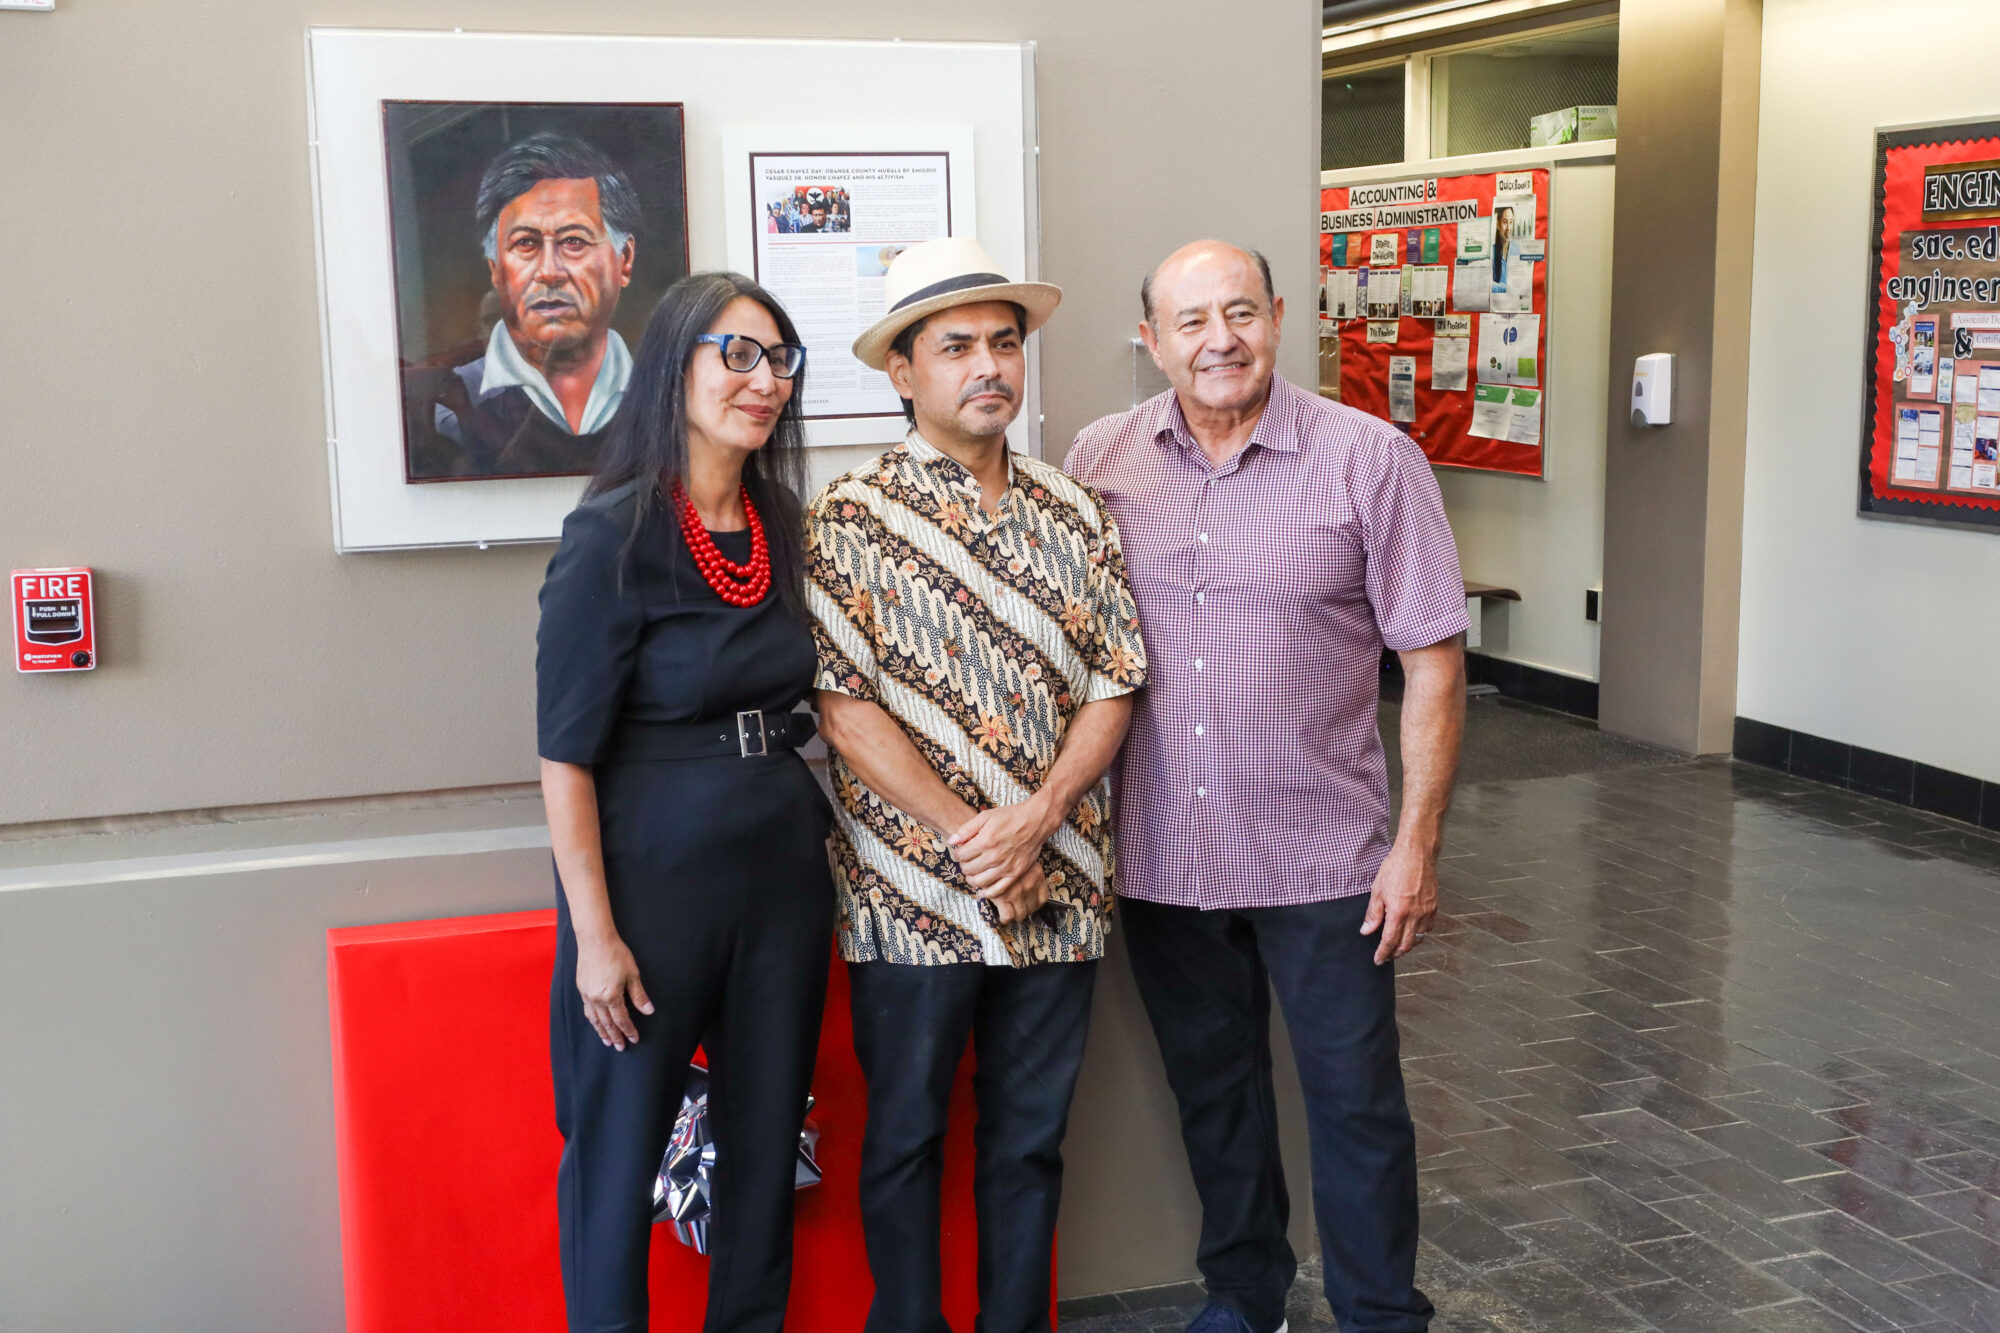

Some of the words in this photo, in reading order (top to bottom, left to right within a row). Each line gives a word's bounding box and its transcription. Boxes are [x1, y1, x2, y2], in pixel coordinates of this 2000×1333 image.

[1351, 184, 1424, 206] ACCOUNTING
[1427, 181, 1437, 199] &
[1321, 213, 1373, 231] BUSINESS
[1376, 203, 1477, 227] ADMINISTRATION
[1912, 226, 2000, 261] sac.ed
[1957, 314, 1989, 324] Associate
[1954, 327, 1974, 360] &
[22, 577, 82, 598] FIRE
